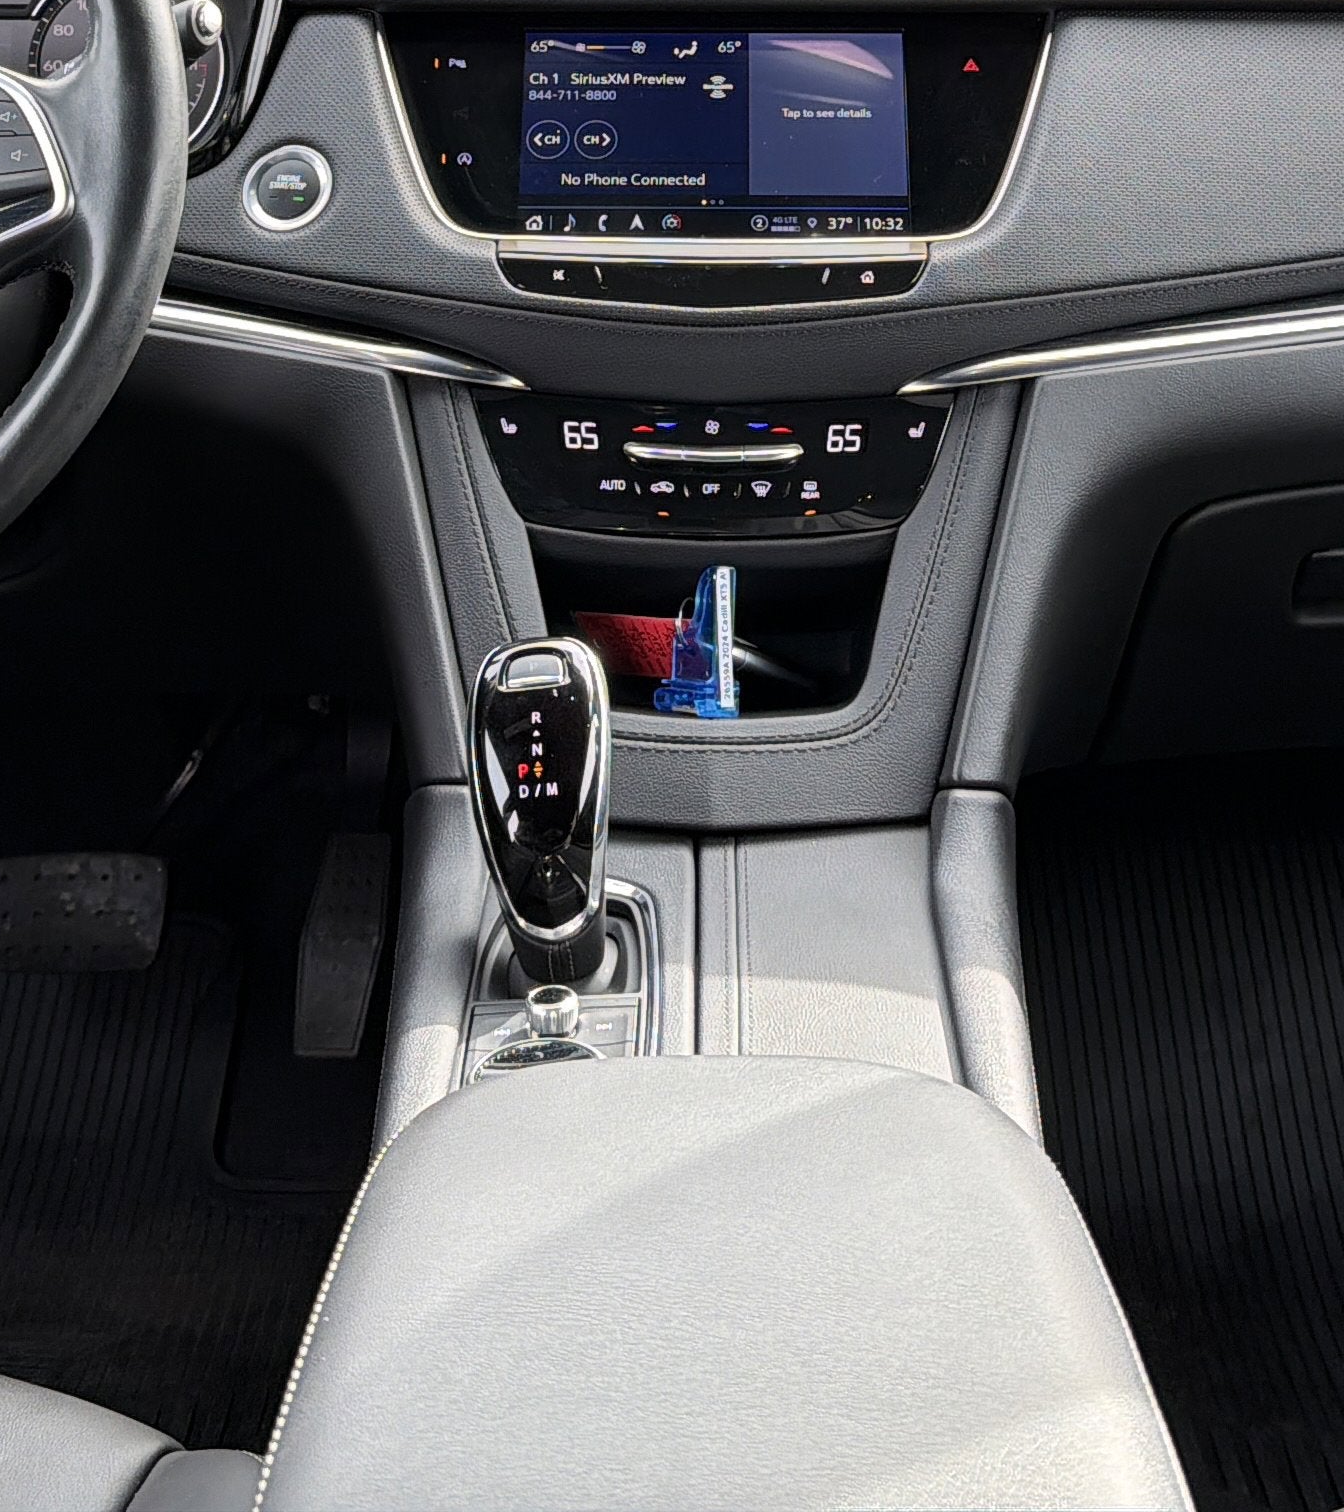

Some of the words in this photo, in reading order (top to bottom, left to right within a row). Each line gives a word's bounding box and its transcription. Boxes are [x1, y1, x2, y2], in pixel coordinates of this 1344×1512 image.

[53, 24, 74, 36] 80
[530, 39, 554, 53] 65°
[717, 40, 742, 54] 65°
[529, 73, 549, 85] Ch
[552, 73, 559, 85] 1
[570, 73, 630, 85] SiriusXM
[633, 73, 687, 85] Preview
[528, 90, 617, 101] 844-711-8800
[781, 108, 801, 120] Tap
[803, 108, 814, 118] to
[816, 110, 834, 118] see
[837, 107, 872, 118] details
[544, 135, 560, 144] CH
[583, 135, 599, 144] CH
[560, 173, 581, 186] No
[584, 173, 628, 186] Phone
[631, 173, 706, 186] Connected
[827, 216, 853, 230] 37°
[864, 216, 904, 231] 10:32
[563, 421, 599, 450] 65
[826, 424, 862, 453] 65
[599, 480, 626, 490] AUTO
[702, 483, 720, 495] OFF
[801, 491, 820, 500] REAR
[531, 711, 542, 724] R
[531, 742, 543, 756] N
[518, 763, 529, 779] P
[518, 784, 529, 798] D
[546, 781, 558, 796] M
